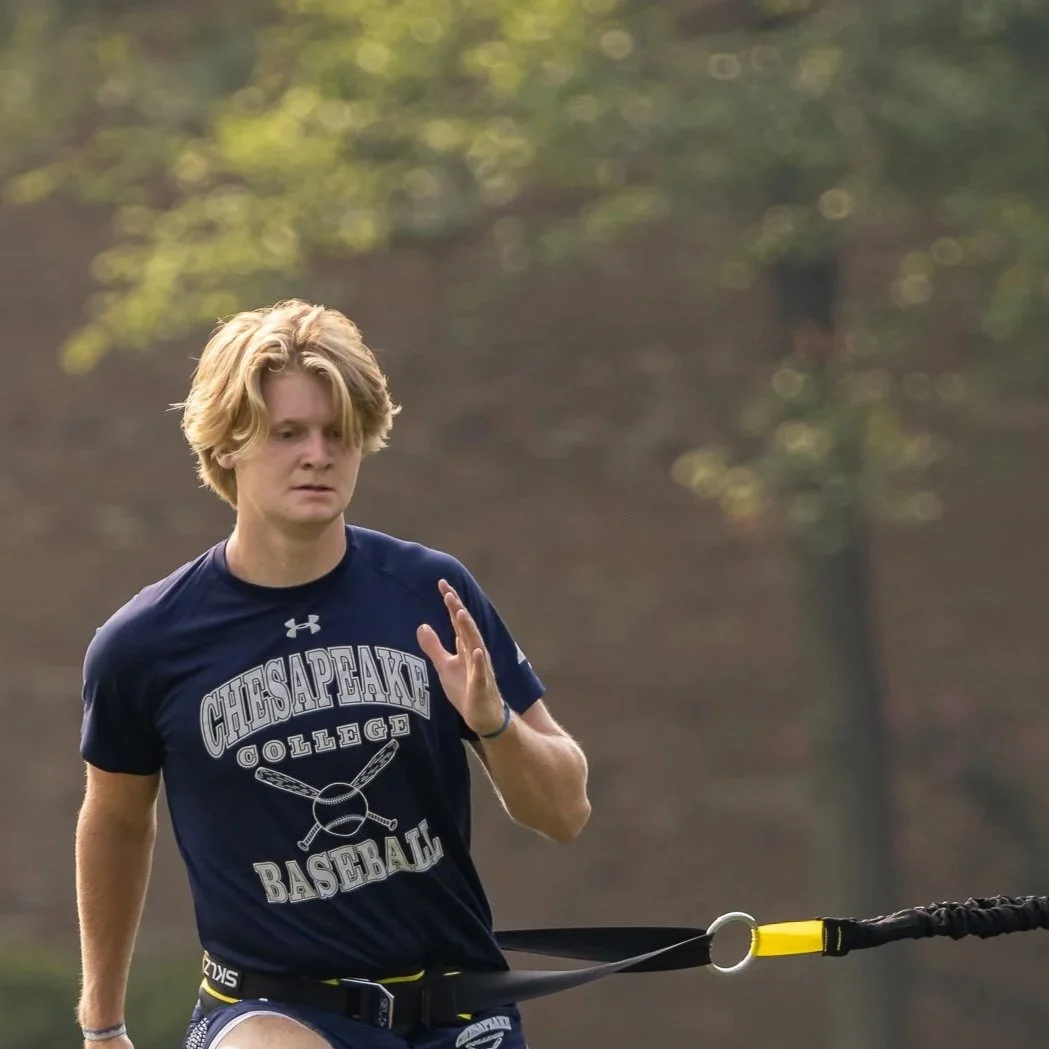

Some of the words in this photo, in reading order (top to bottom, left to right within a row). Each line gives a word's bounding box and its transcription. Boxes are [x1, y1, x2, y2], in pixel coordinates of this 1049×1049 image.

[200, 645, 430, 758] CHESAPEAKE
[236, 713, 410, 768] COLLEGE
[253, 819, 444, 903] BASEBALL
[203, 957, 239, 988] SKLZ
